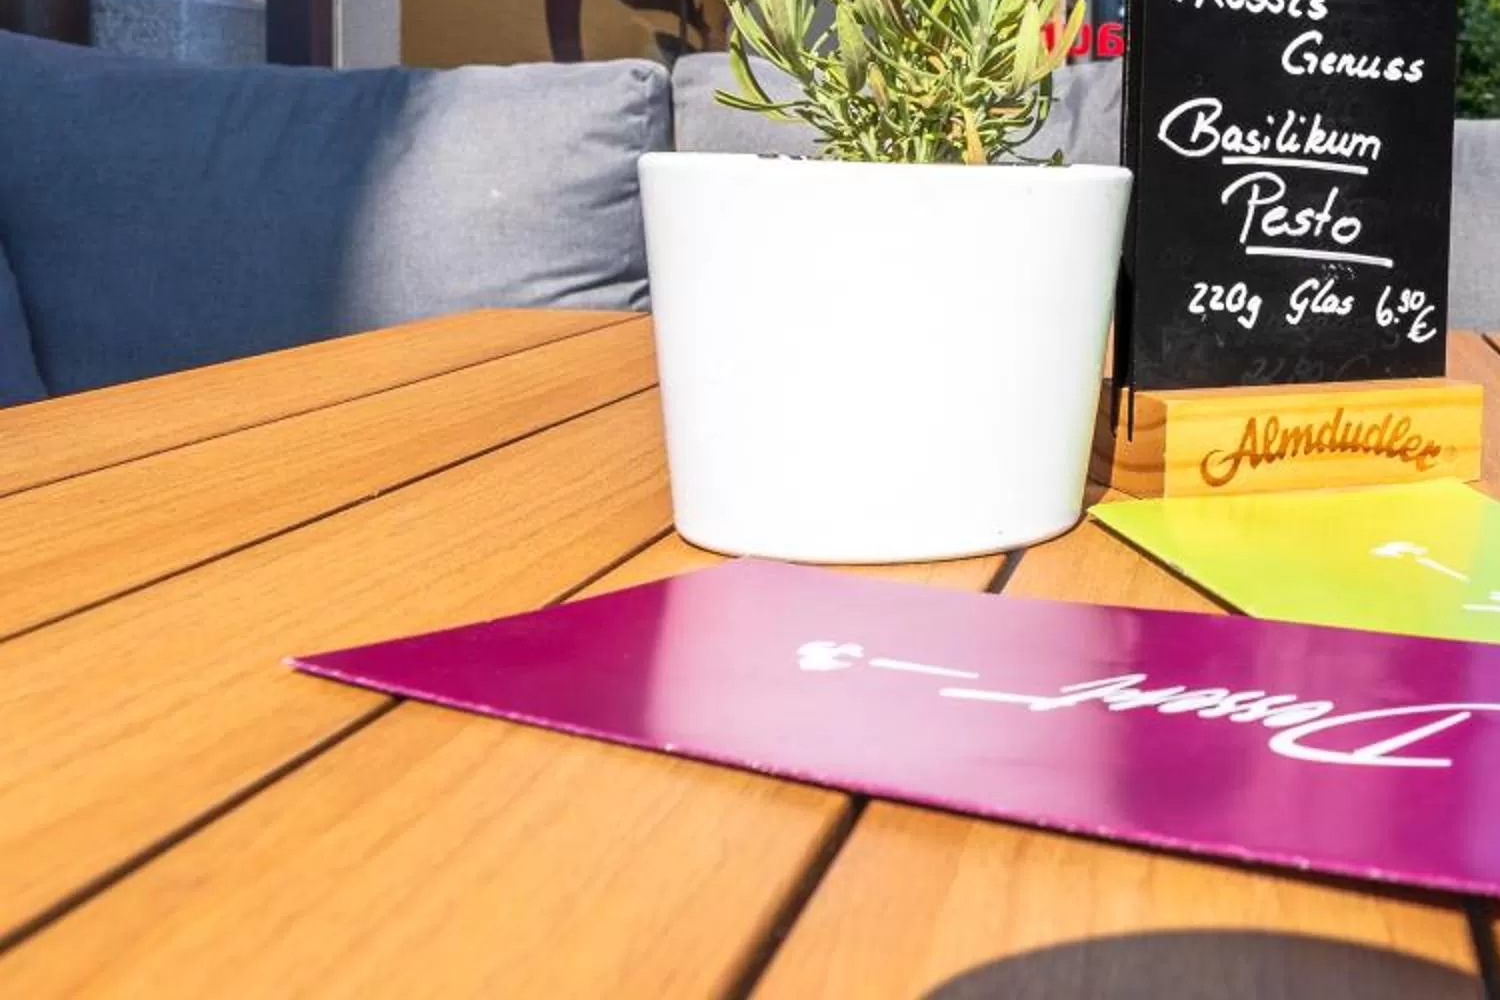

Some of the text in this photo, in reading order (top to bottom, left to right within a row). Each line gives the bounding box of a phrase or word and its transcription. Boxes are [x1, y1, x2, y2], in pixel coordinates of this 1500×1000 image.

[1281, 29, 1426, 83] Genuss
[1157, 97, 1382, 161] Basilikum
[1221, 171, 1362, 244] Pesto
[1188, 282, 1263, 330] 220g
[1286, 277, 1355, 325] Glas
[1200, 407, 1442, 487] Almdudler
